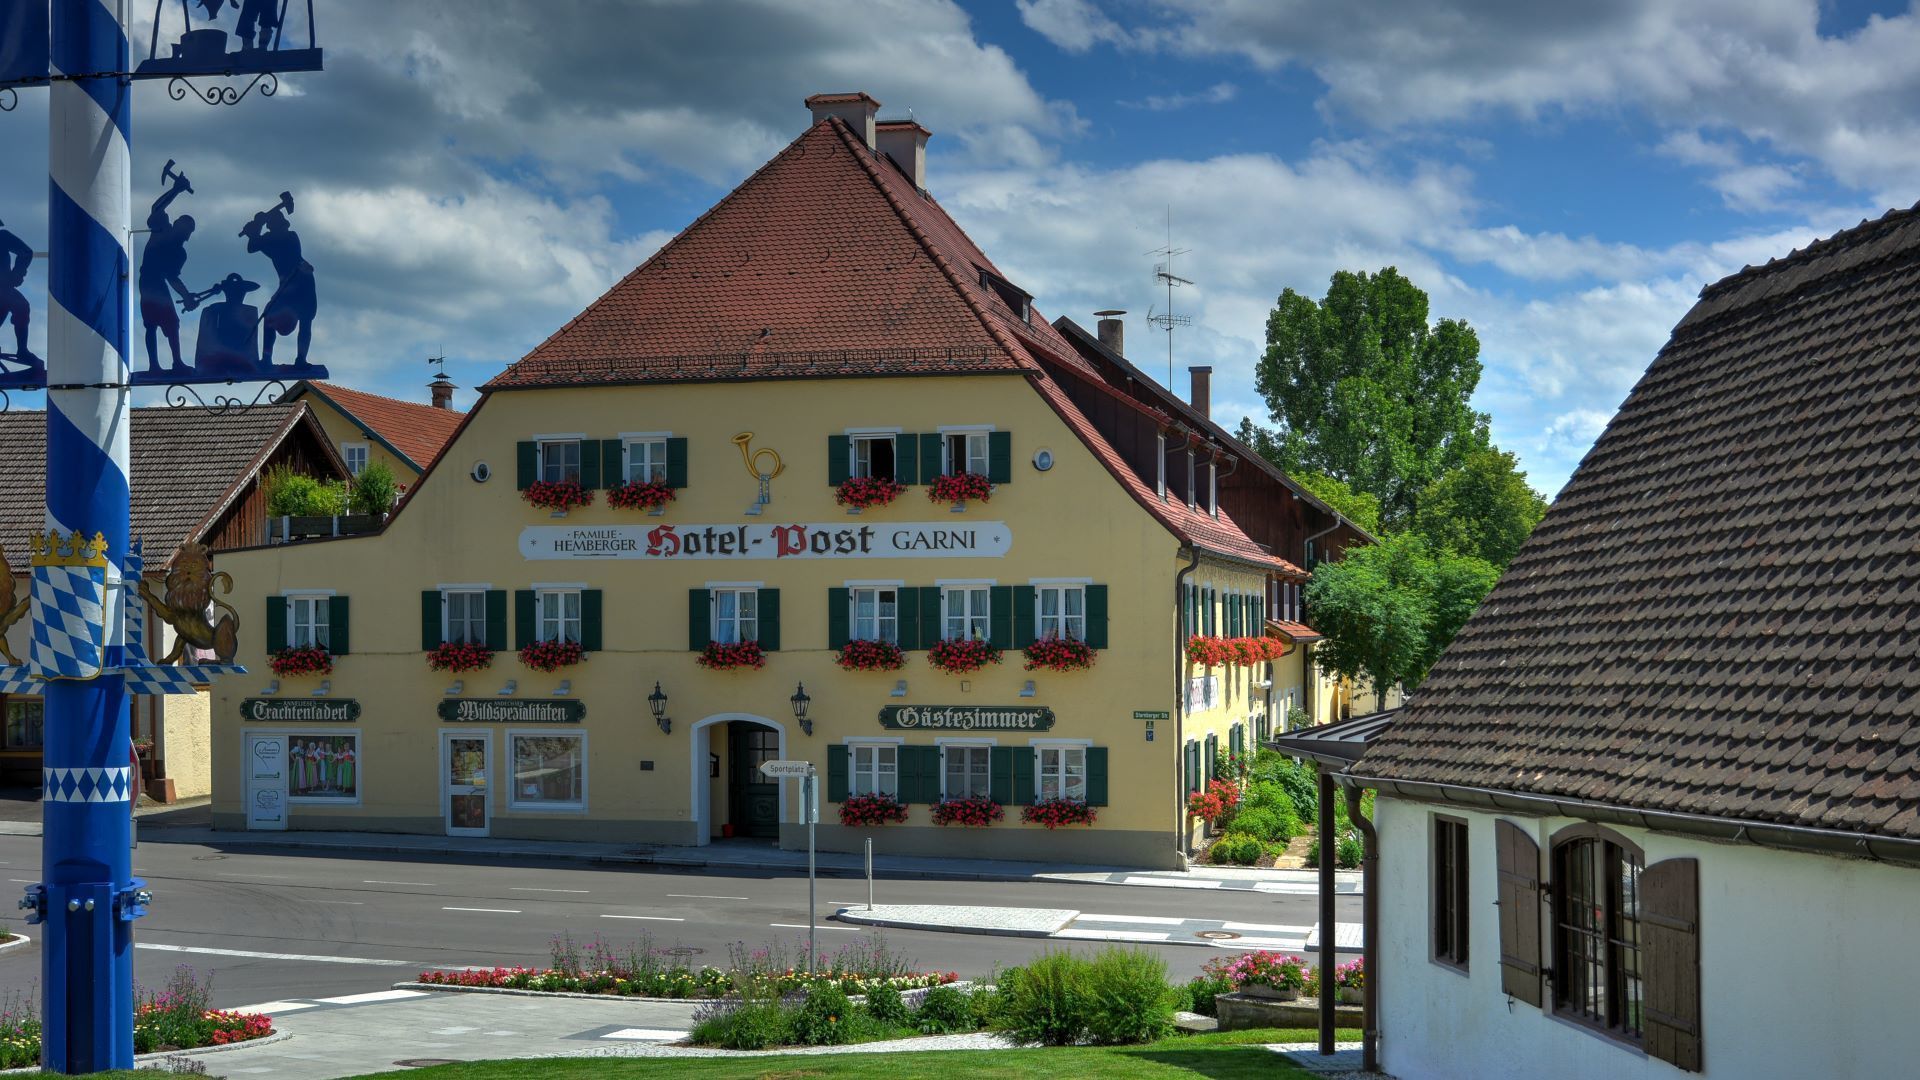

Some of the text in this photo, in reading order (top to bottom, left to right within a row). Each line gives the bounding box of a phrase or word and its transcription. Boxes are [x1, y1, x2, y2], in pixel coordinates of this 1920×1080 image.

[573, 530, 617, 539] FAMILIE
[892, 530, 976, 550] GARNI
[554, 539, 637, 551] HEMBERGER
[457, 700, 568, 722] Wildspezialitäten
[896, 706, 1043, 730] Gästezimmer
[770, 764, 805, 774] Sportplatz
